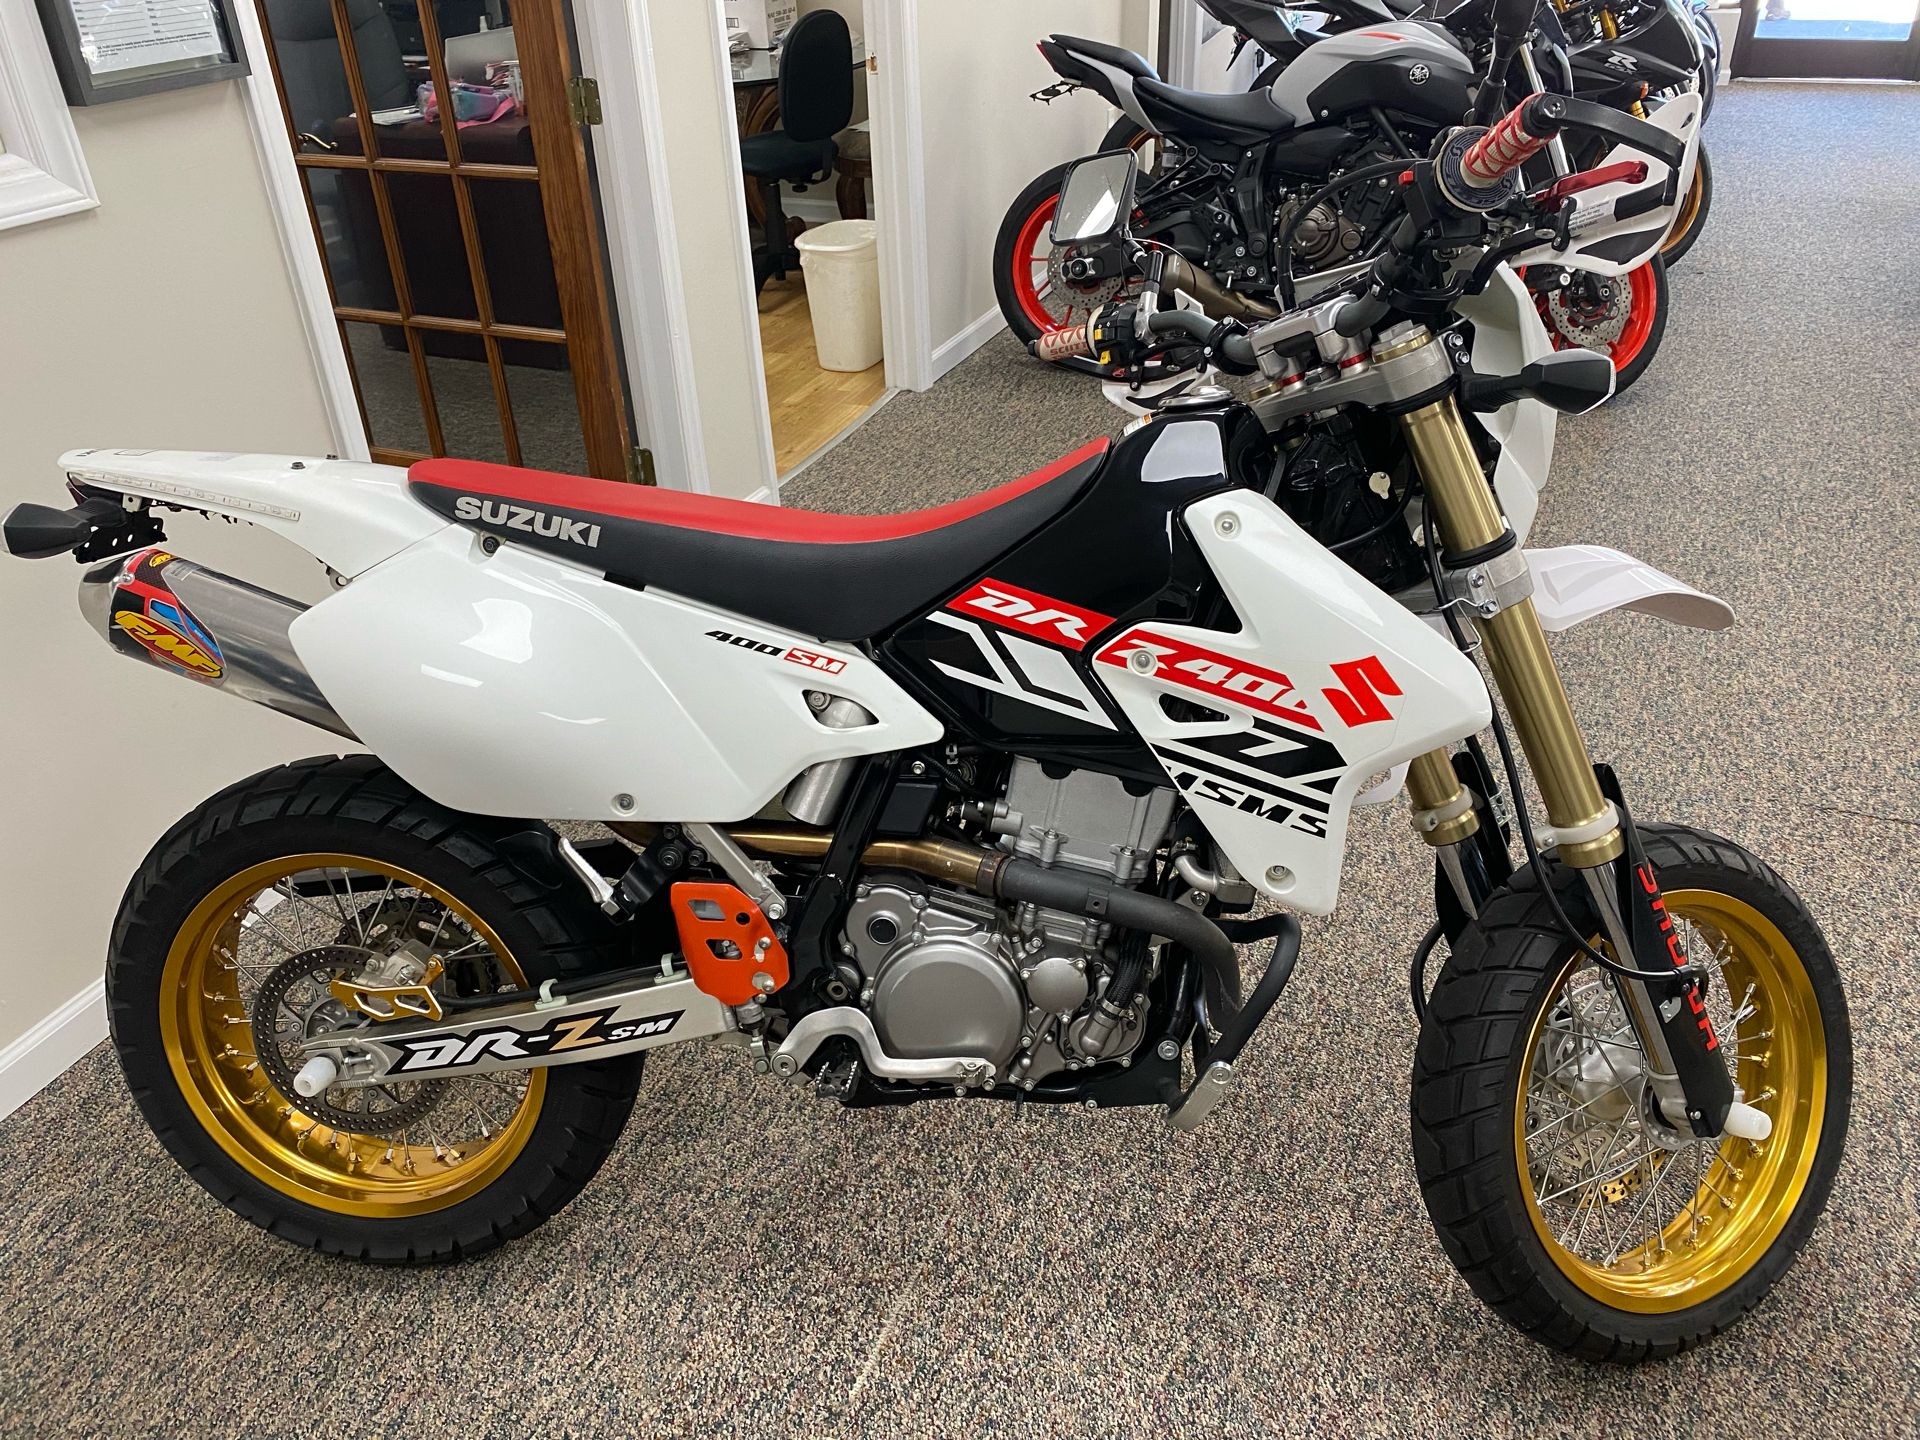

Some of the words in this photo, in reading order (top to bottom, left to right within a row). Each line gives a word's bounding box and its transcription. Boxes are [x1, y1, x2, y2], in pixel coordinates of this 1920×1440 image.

[454, 496, 602, 548] SUZUKI
[966, 585, 1087, 642] DR
[114, 610, 223, 678] FMF
[704, 630, 787, 656] 400
[785, 648, 847, 675] SM
[402, 1016, 606, 1071] DR-Z
[608, 1017, 674, 1041] SM
